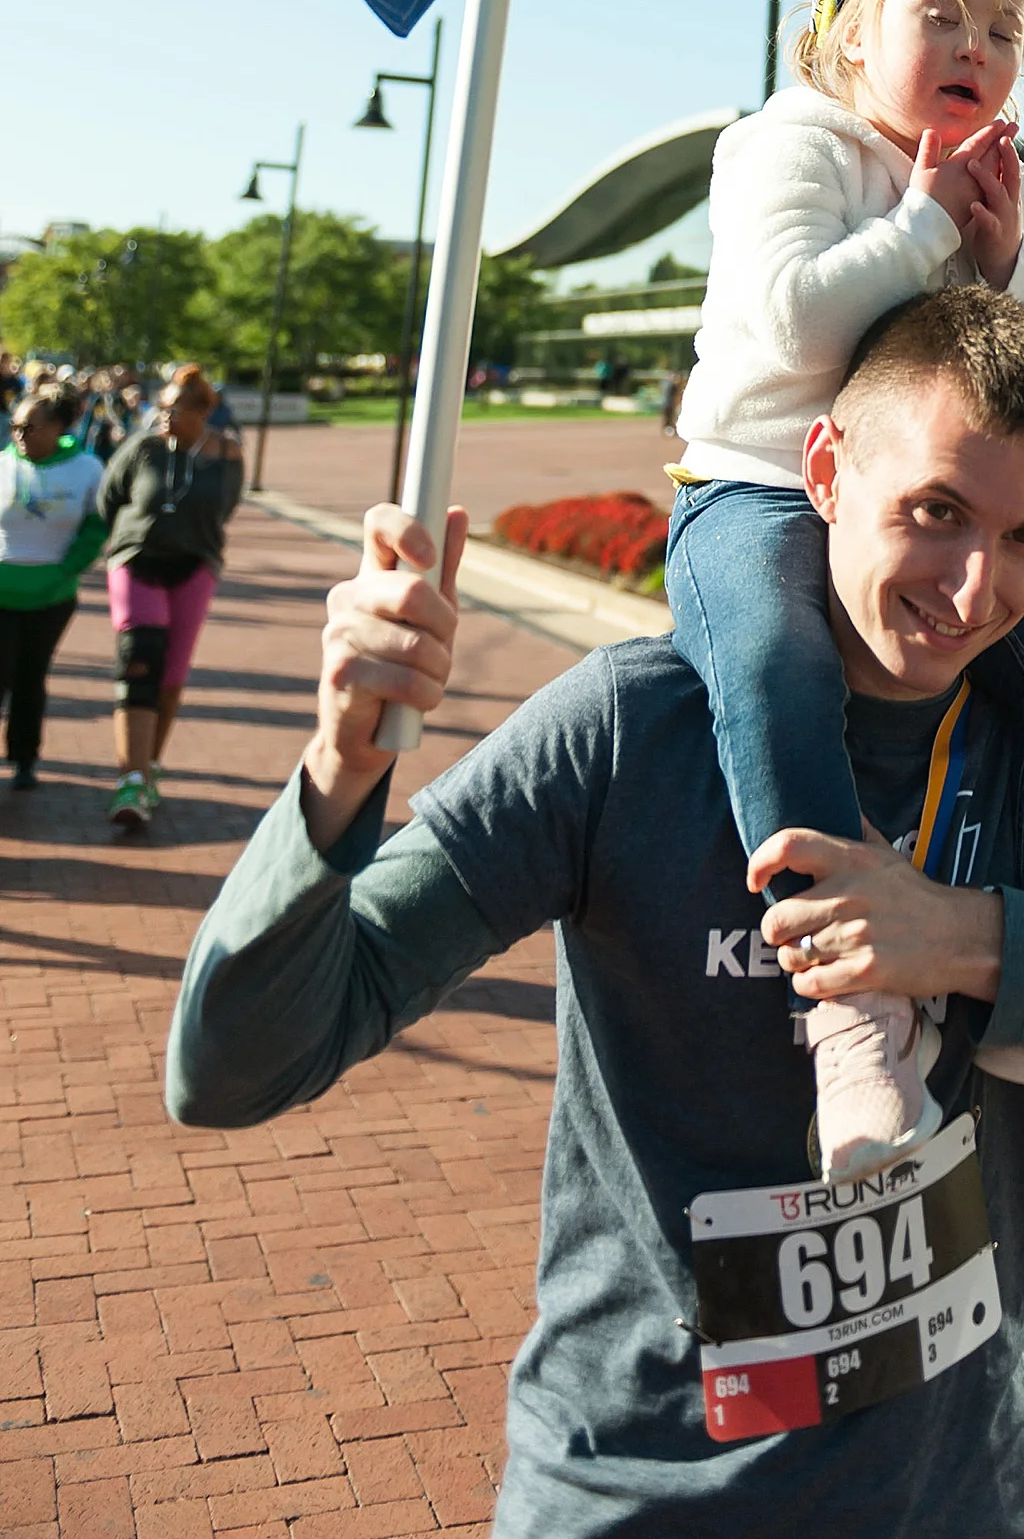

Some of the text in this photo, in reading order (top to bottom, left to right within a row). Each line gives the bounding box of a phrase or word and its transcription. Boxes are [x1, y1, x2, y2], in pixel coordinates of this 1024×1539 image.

[777, 1193, 934, 1328] 694
[827, 1303, 905, 1342] T3RUN.COM
[927, 1306, 954, 1338] 694
[826, 1348, 862, 1379] 694
[927, 1343, 938, 1364] 3
[714, 1373, 751, 1399] 694
[826, 1383, 840, 1406] 2
[713, 1405, 726, 1427] 1
